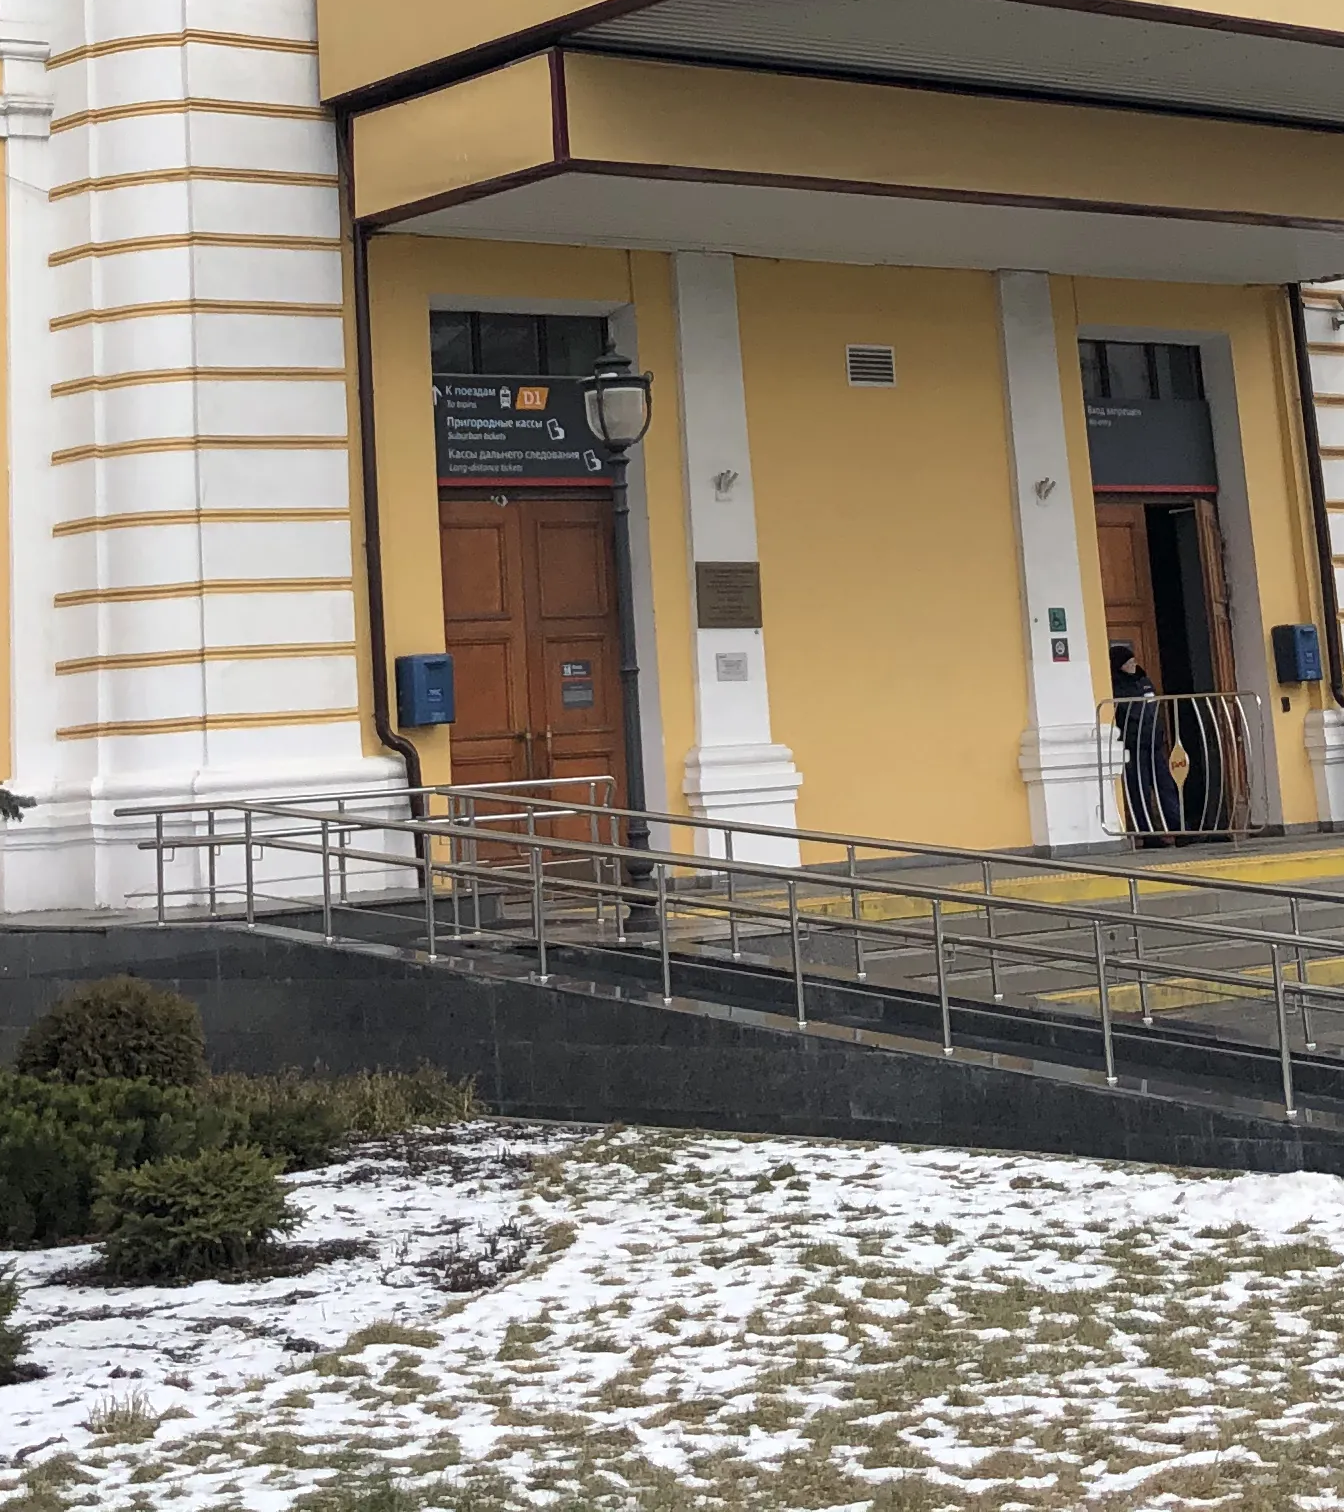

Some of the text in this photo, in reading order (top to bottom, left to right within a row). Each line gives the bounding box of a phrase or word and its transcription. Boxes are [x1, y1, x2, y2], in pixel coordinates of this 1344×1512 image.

[445, 385, 496, 398] К поездам
[523, 390, 542, 405] D1
[447, 416, 543, 430] Пригородные кассы
[448, 448, 580, 461] Кассы дальнего следования
